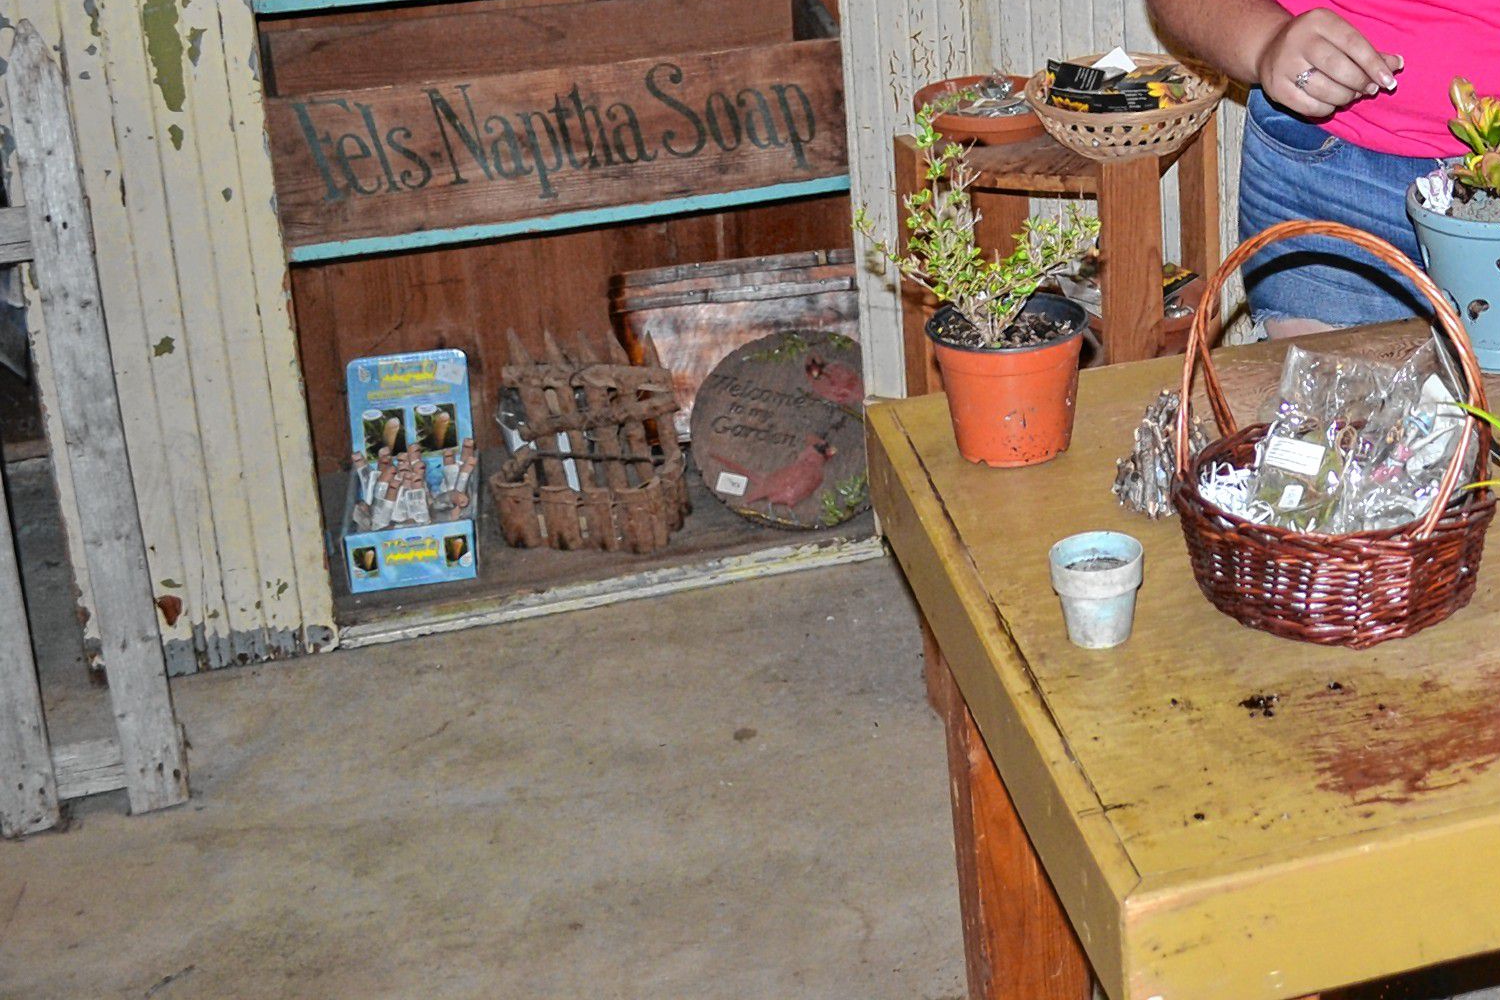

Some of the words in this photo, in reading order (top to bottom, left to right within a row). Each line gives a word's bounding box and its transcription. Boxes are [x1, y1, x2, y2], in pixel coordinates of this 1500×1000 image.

[645, 62, 816, 170] Soap
[705, 373, 806, 409] Welcome
[711, 415, 797, 447] Garden
